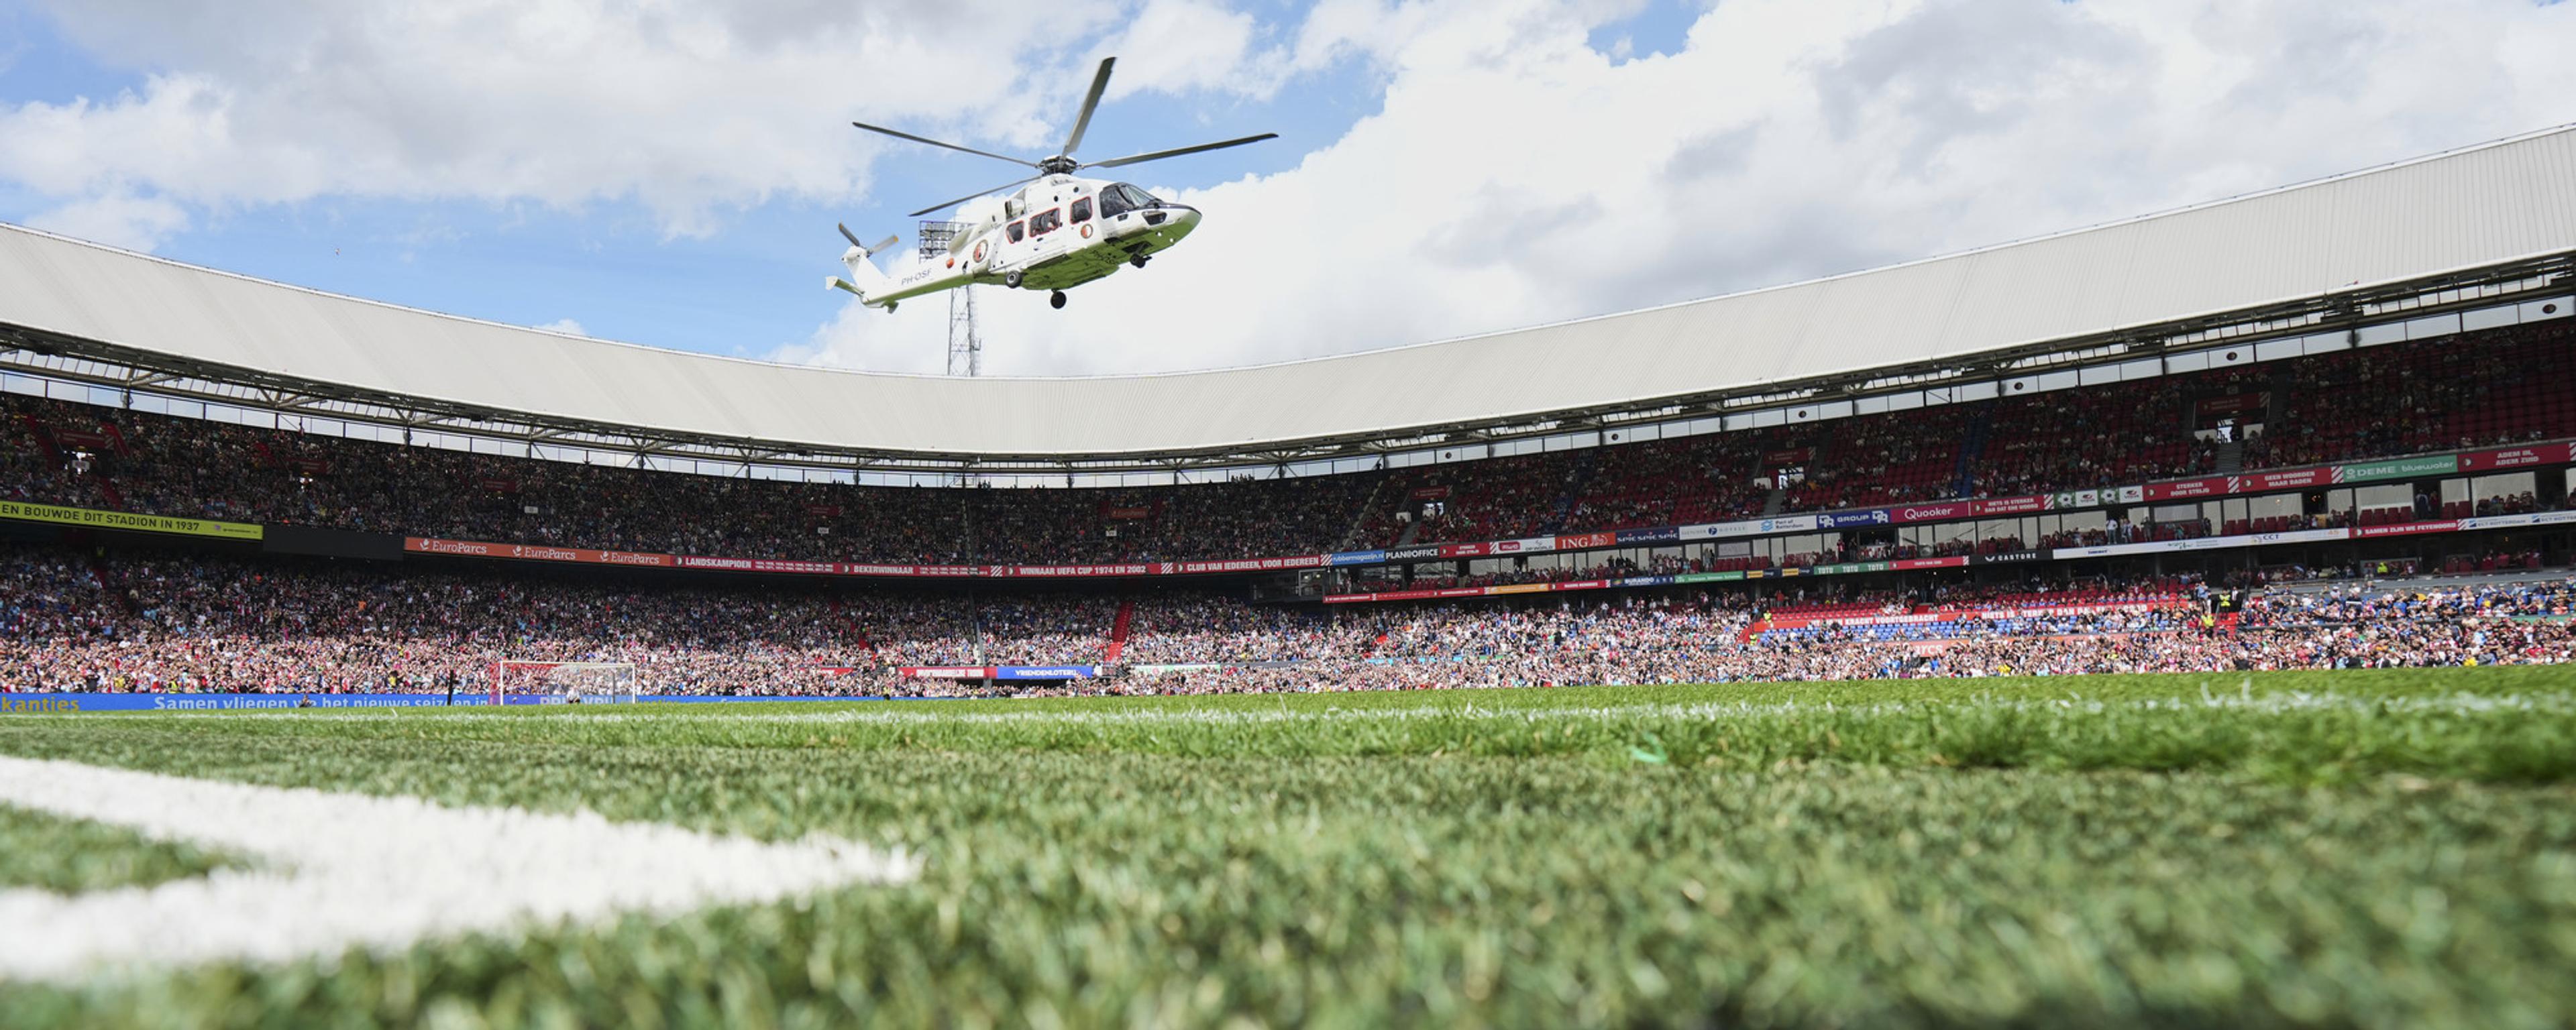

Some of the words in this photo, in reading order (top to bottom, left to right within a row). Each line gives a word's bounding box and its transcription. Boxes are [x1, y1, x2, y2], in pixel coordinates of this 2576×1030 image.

[2357, 466, 2396, 477] DEME
[2402, 461, 2453, 473] bluewater
[3, 504, 19, 514] EN
[25, 506, 79, 520] BOUWDE
[85, 512, 103, 522] DIT
[107, 515, 156, 527] STADION
[161, 520, 172, 529] IN
[176, 522, 199, 531] 1937
[1837, 514, 1869, 523] GROUP
[1904, 508, 1952, 520] Quooker
[2418, 522, 2457, 531] FEYENOORD
[432, 540, 487, 554] EuroParcs
[1562, 537, 1588, 549] ING
[525, 547, 576, 560] EuroParcs
[611, 552, 659, 565] EuroParcs
[1998, 553, 2036, 561] CASTORE
[686, 557, 751, 569] LANDSKAMPIOEN
[1187, 563, 1205, 571] CLUB
[1208, 563, 1222, 571] VAN
[1224, 561, 1261, 570] IEDEREEN,
[1263, 559, 1282, 568] VOOR
[1284, 557, 1319, 567] IEDEREEN
[1868, 563, 1884, 571] TOTO
[854, 565, 913, 574] BEKERWINNAAR
[1020, 567, 1055, 575] WINNAAR
[1057, 567, 1075, 575] UEFA
[1077, 566, 1093, 575] CUP
[1095, 566, 1113, 574] 1974
[1116, 565, 1125, 574] EN
[1127, 565, 1146, 573] 2002
[1982, 611, 2004, 619] NIETS
[2057, 607, 2074, 616] DAN
[1845, 617, 1873, 625] KRACHT
[1875, 614, 1938, 624] VOORTGEBRACHT
[2, 697, 80, 711] kanties
[154, 696, 217, 709] Samen
[223, 697, 288, 709] vliegen
[323, 697, 348, 707] het
[354, 697, 410, 707] nieuwe
[415, 697, 470, 707] seizen
